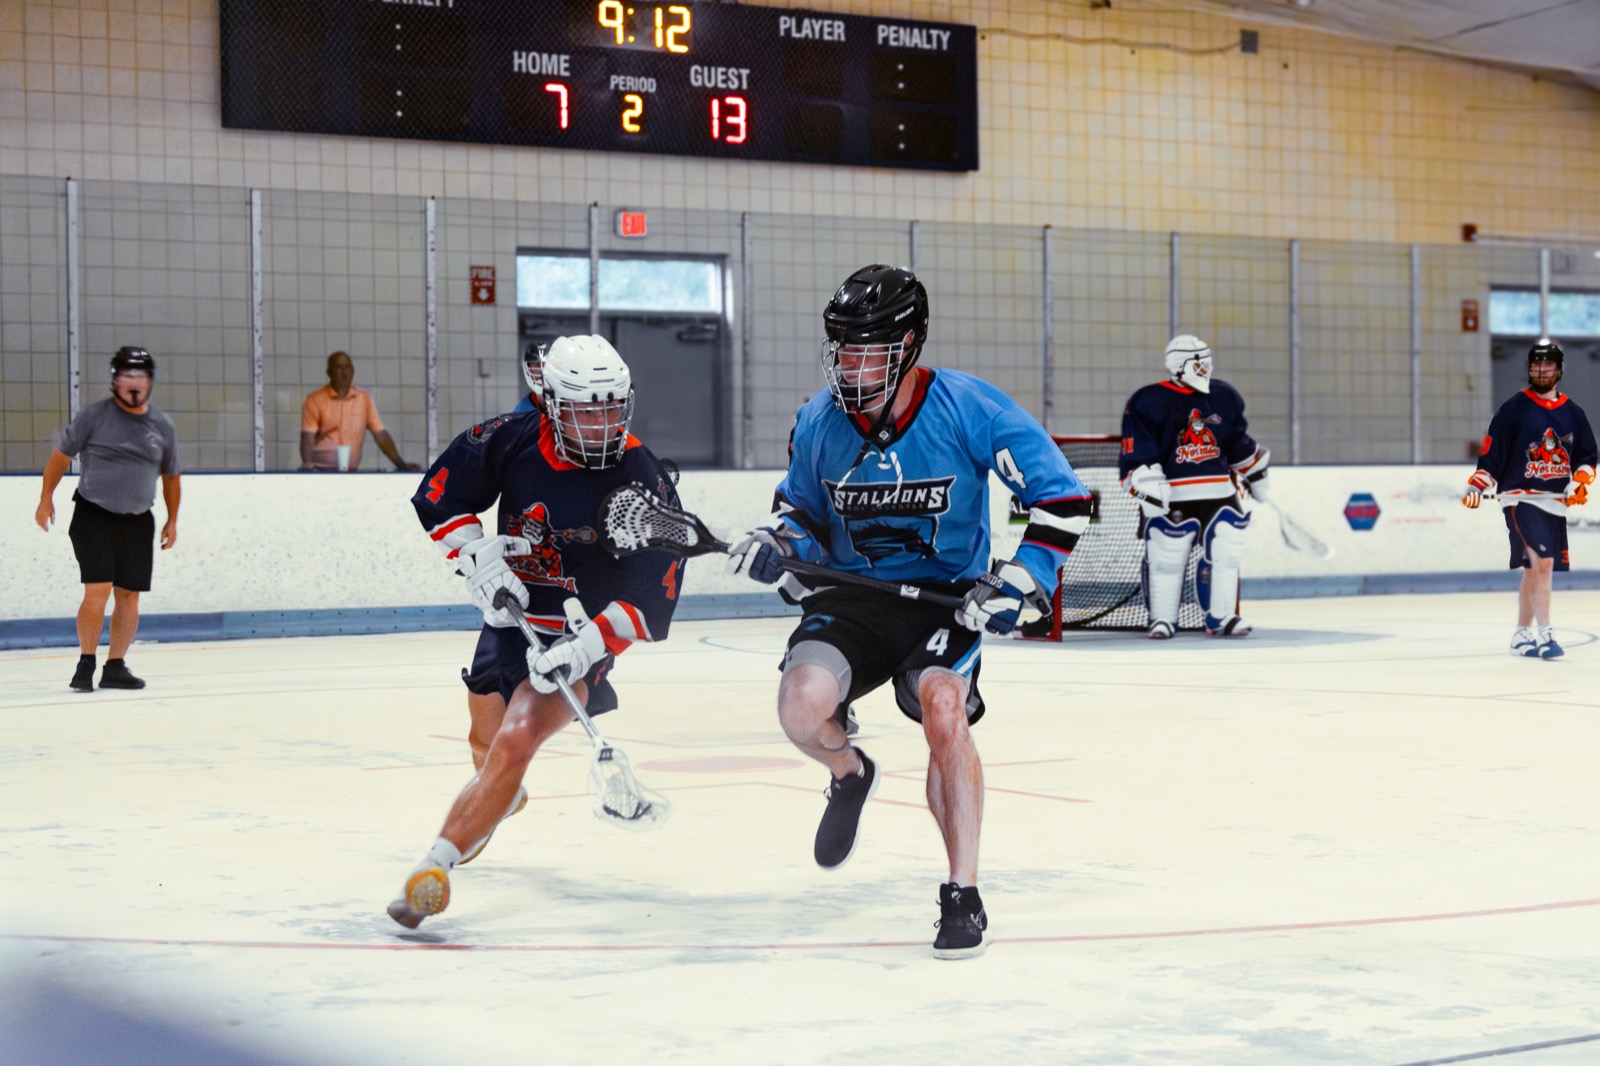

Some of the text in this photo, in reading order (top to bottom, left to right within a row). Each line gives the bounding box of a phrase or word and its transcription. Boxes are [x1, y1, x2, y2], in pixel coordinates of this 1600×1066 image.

[599, 0, 691, 52] 9:12
[779, 16, 846, 42] PLAYER
[877, 25, 951, 50] PENALTY
[513, 51, 571, 76] HOME
[690, 65, 750, 90] GUEST
[610, 75, 656, 93] PERIOD
[545, 82, 568, 129] 7
[622, 94, 643, 132] 2
[710, 97, 747, 144] 13
[995, 448, 1025, 489] 4
[425, 467, 449, 504] 4
[834, 486, 945, 511] STALLIONS
[661, 560, 679, 600] 4
[926, 628, 950, 656] 4
